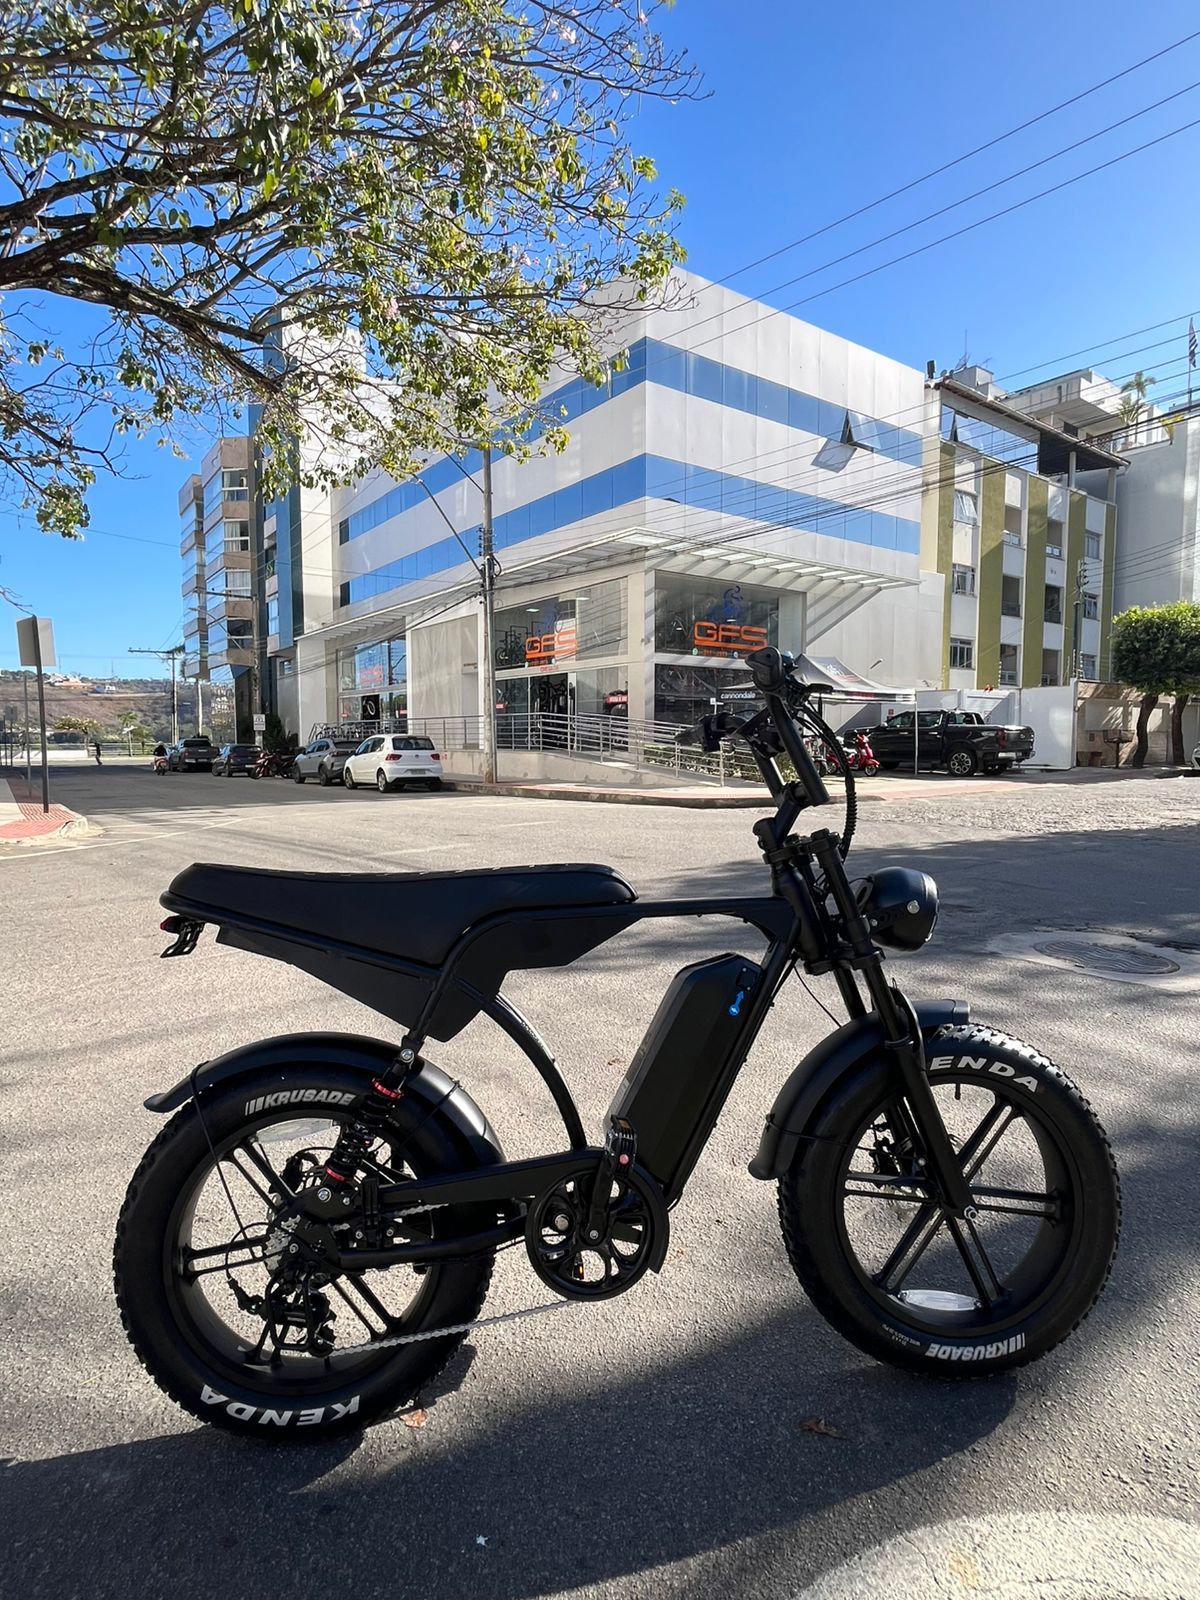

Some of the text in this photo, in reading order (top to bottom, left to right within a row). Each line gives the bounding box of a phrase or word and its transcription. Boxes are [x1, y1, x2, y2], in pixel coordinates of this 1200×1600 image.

[525, 629, 577, 659] GFS
[694, 621, 768, 651] GFS
[720, 691, 756, 699] cannondale
[930, 1056, 1038, 1092] ENDA
[264, 1089, 356, 1109] KRUSADE
[925, 1340, 1008, 1361] KRUSADE
[200, 1384, 360, 1427] KENDA
